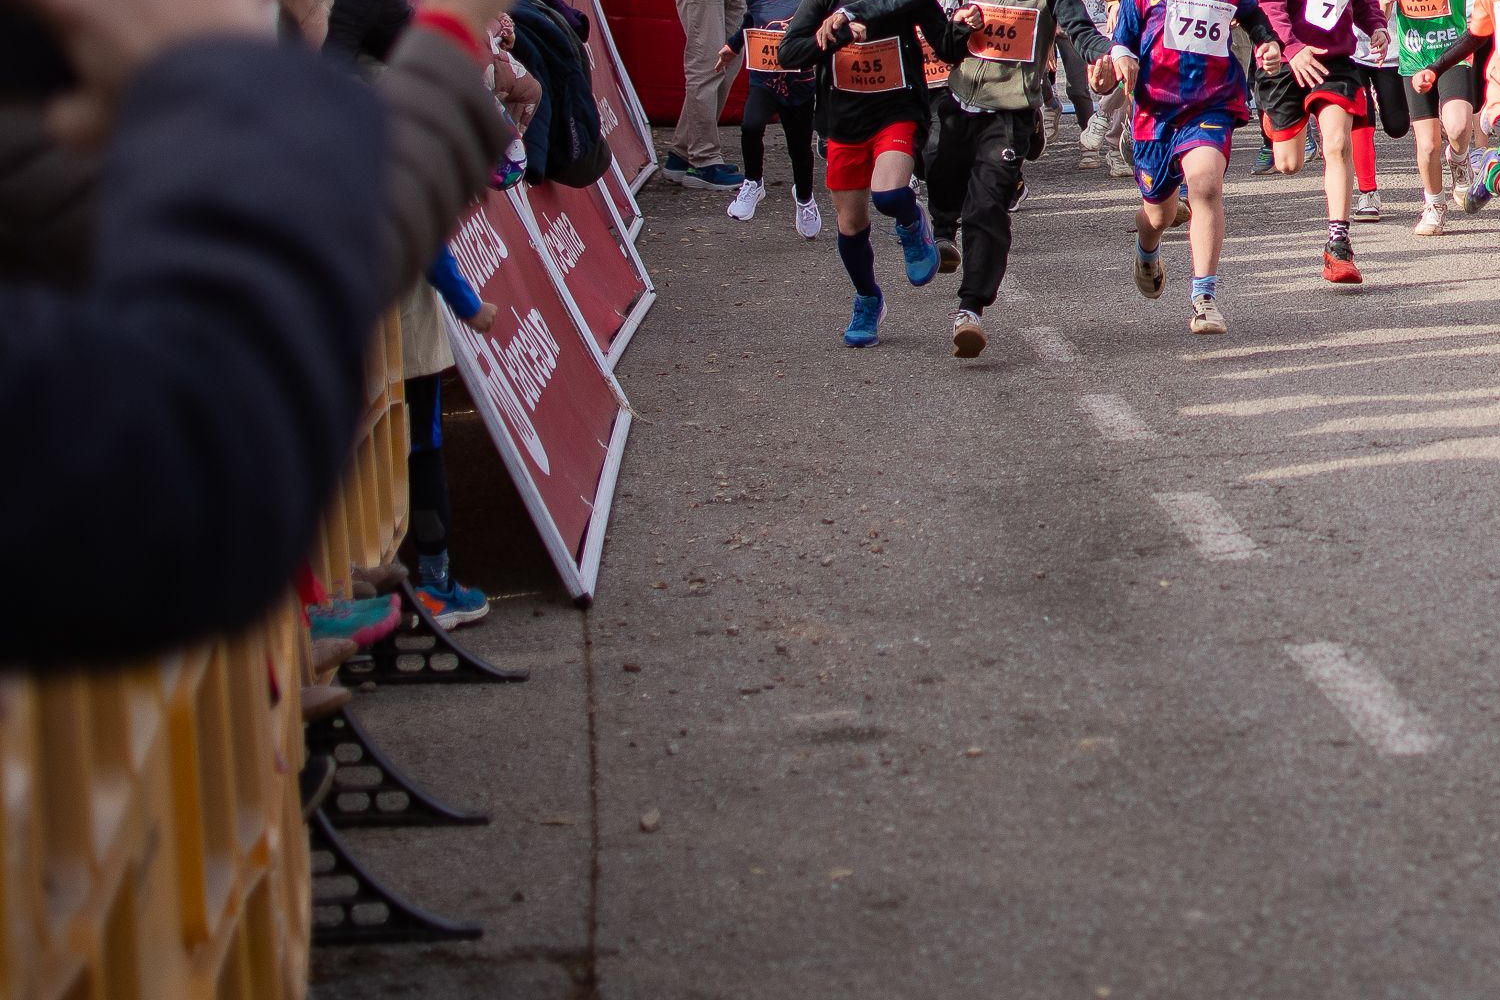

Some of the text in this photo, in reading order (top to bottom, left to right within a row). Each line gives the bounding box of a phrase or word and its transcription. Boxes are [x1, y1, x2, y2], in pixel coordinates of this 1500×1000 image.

[1406, 4, 1438, 13] MARIA
[983, 23, 1017, 40] 446
[1178, 16, 1221, 41] 756
[851, 59, 883, 73] 435
